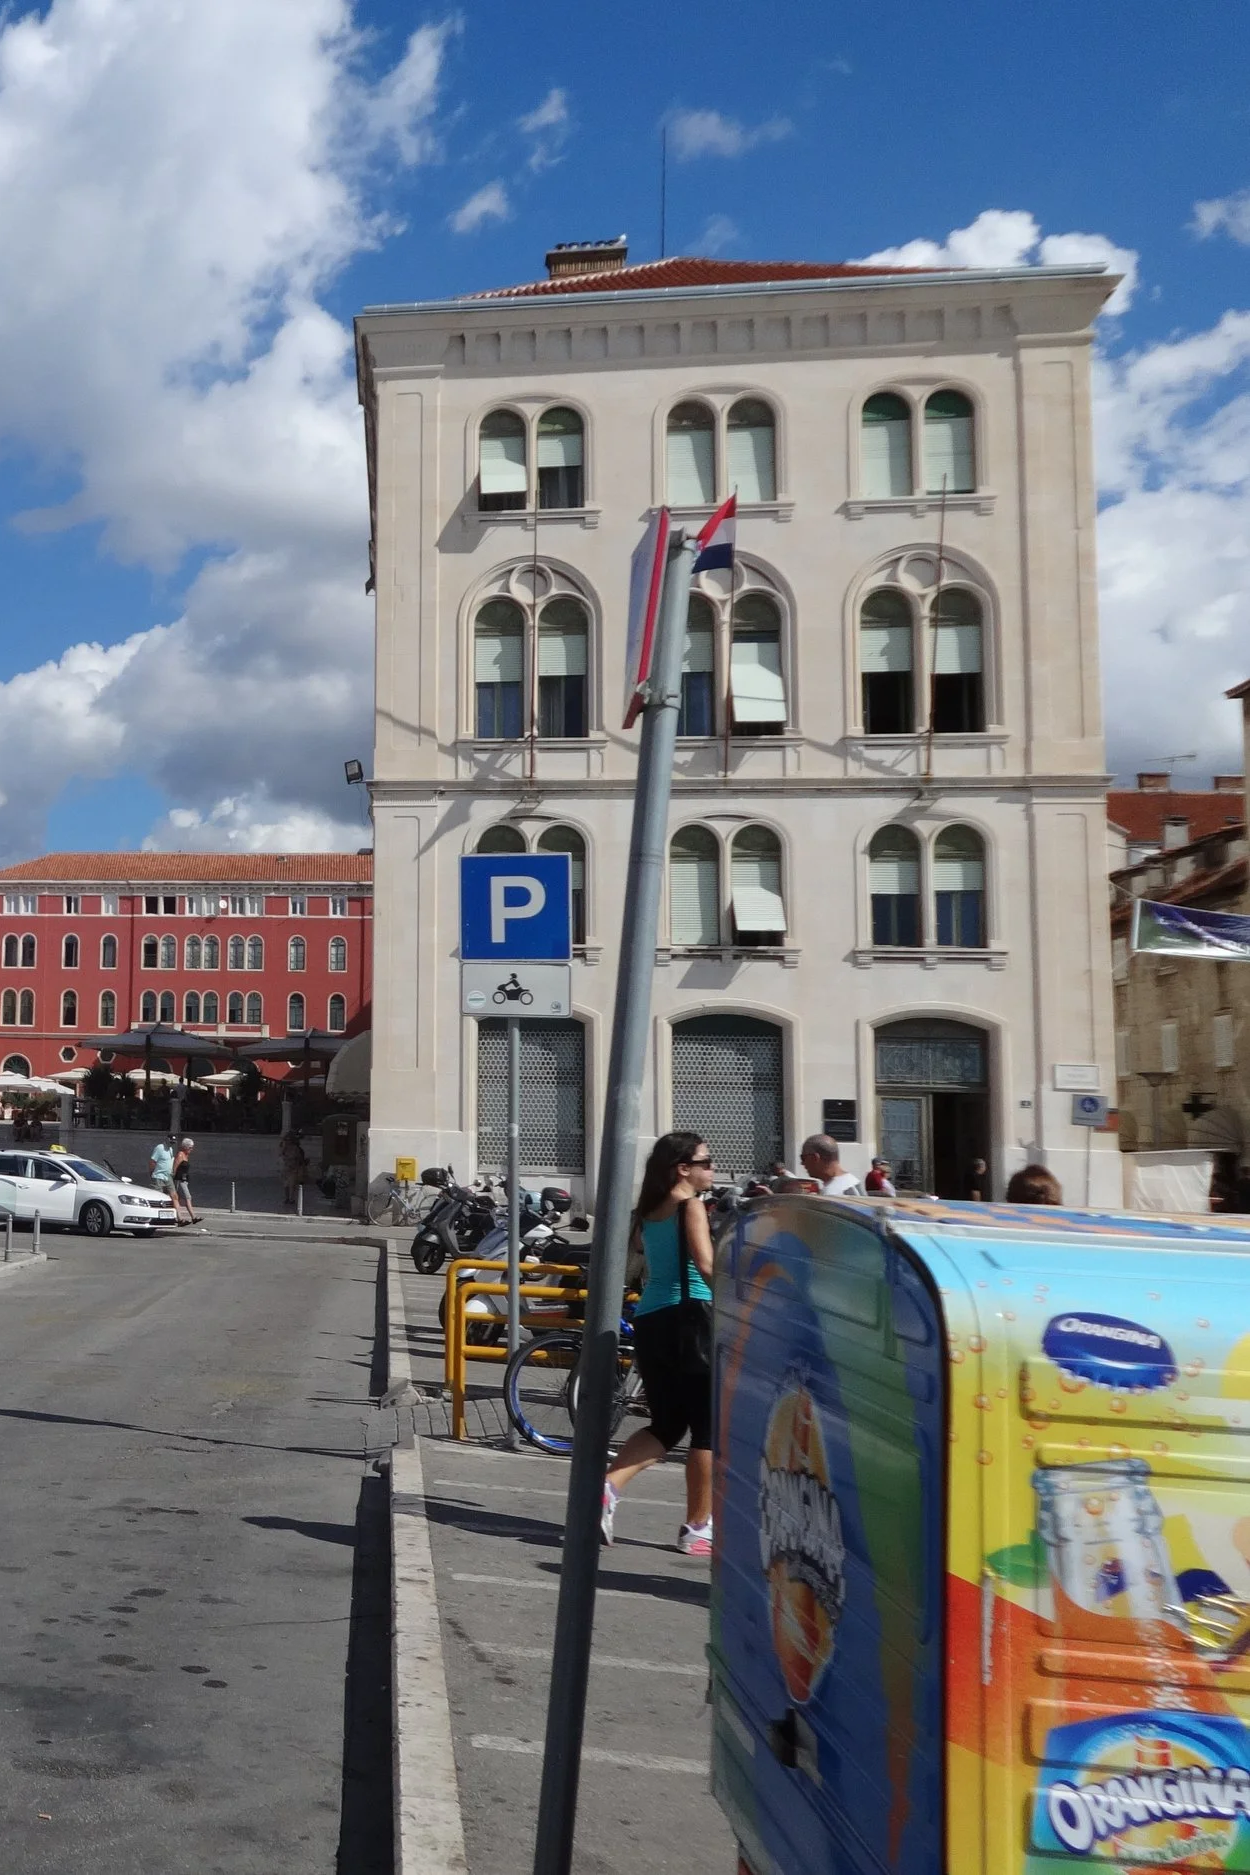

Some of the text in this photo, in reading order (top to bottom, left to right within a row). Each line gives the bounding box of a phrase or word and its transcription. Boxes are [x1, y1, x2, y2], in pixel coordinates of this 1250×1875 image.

[490, 876, 546, 943] P
[1057, 1317, 1161, 1349] ORANGINA
[1048, 1765, 1250, 1855] ORANGINA
